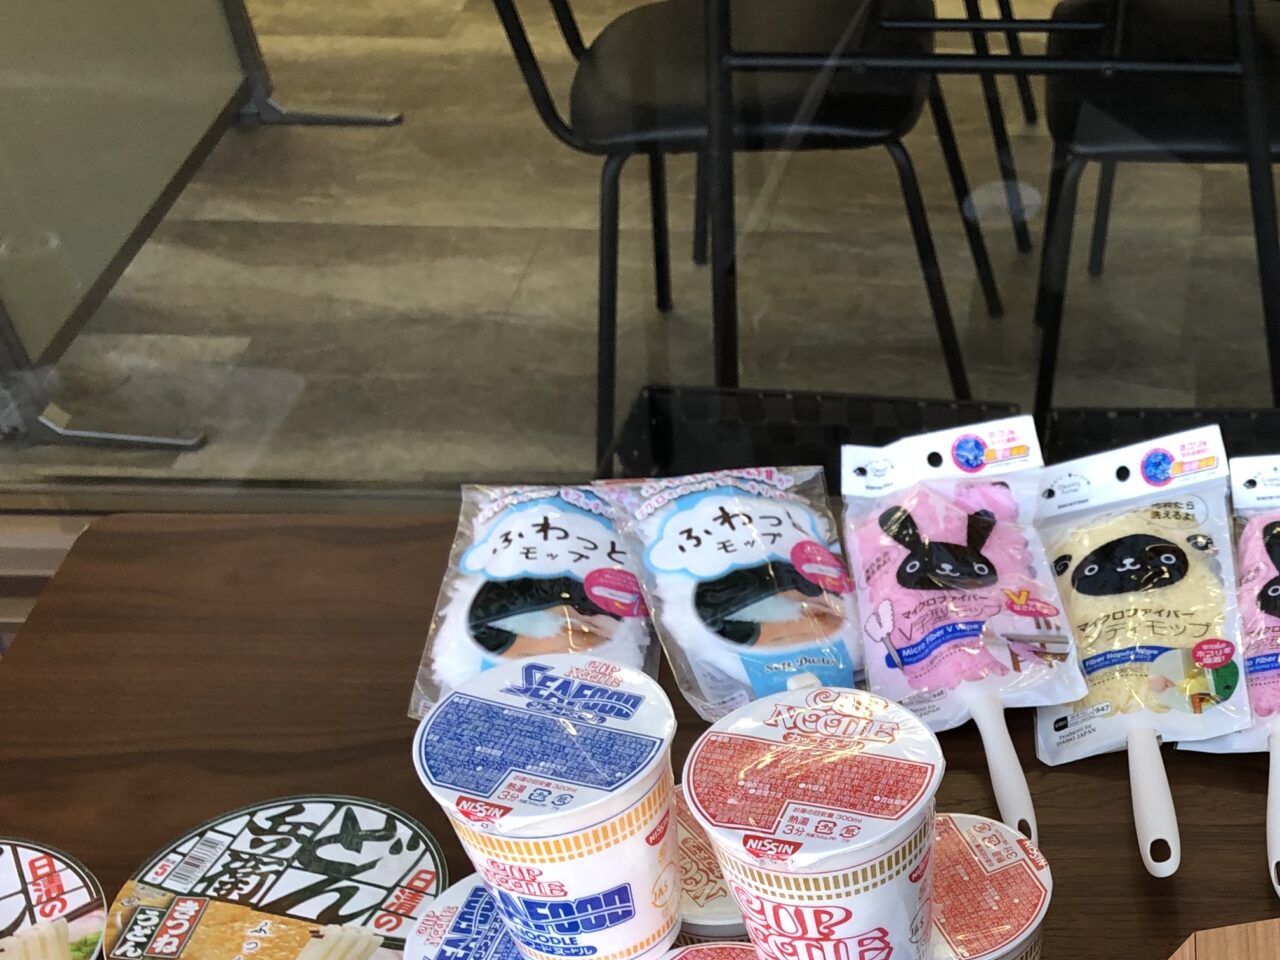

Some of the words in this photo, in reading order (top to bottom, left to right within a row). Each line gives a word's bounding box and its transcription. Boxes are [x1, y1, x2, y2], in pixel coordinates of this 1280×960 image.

[492, 515, 628, 565] ふわっと
[717, 532, 782, 554] モップ
[520, 546, 590, 563] モップ
[1077, 608, 1195, 632] マイクロファイバー
[902, 641, 926, 658] Micro
[926, 629, 944, 648] Fiber
[1084, 620, 1211, 650] ンディモップ
[585, 661, 621, 676] CUP
[499, 662, 646, 721] SEAFOOD
[1094, 704, 1110, 714] 947
[764, 704, 899, 744] NOODLE
[458, 800, 504, 819] NISSIN
[783, 825, 804, 836] 3分
[746, 839, 794, 855] NISSIN
[487, 859, 543, 882] CUP
[374, 868, 436, 932] 日清の
[730, 881, 853, 941] CUP
[114, 910, 160, 957] うどん
[153, 902, 200, 954] きつね
